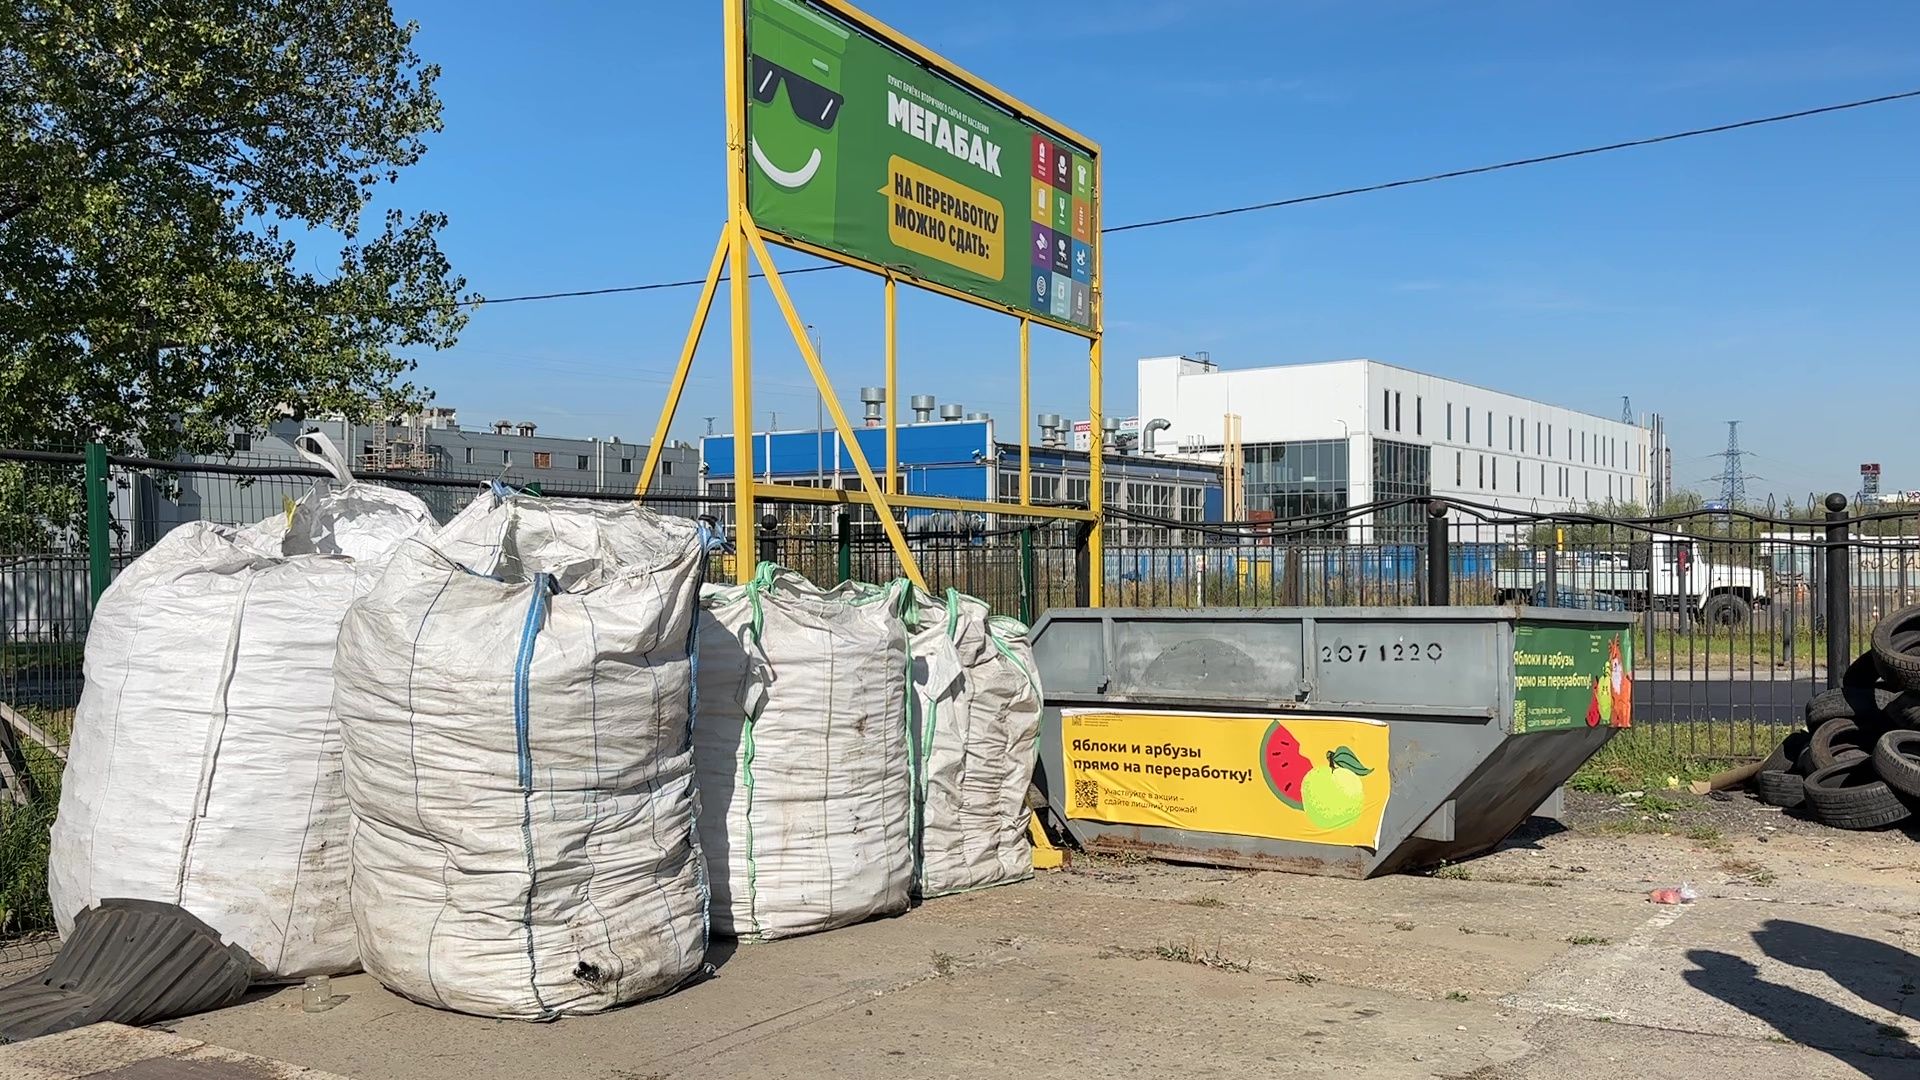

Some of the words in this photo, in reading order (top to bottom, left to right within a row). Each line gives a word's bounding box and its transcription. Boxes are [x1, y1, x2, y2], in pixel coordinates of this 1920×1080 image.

[888, 90, 1002, 178] МЕГАБАК
[895, 172, 913, 201] НА
[916, 181, 999, 234] ПЕРЕРАБОТКУ
[895, 203, 946, 243] МОЖНО
[949, 224, 990, 260] СДАТЬ:
[1513, 650, 1541, 666] Яблоки
[1542, 655, 1547, 666] и
[1548, 651, 1575, 669] арбузы
[1514, 674, 1536, 691] прямо
[1537, 675, 1547, 688] на
[1548, 672, 1592, 690] переработку!
[1072, 739, 1127, 755] Яблоки
[1131, 744, 1141, 755] и
[1145, 743, 1201, 760] арбузы
[1073, 760, 1119, 773] прямо
[1124, 763, 1141, 774] на
[1145, 763, 1252, 784] переработку!
[1103, 788, 1147, 800] Участвуйте
[1154, 793, 1178, 803] акции
[1104, 797, 1130, 808] сдайте
[1131, 799, 1164, 811] лишний
[1164, 803, 1198, 815] урожай!
